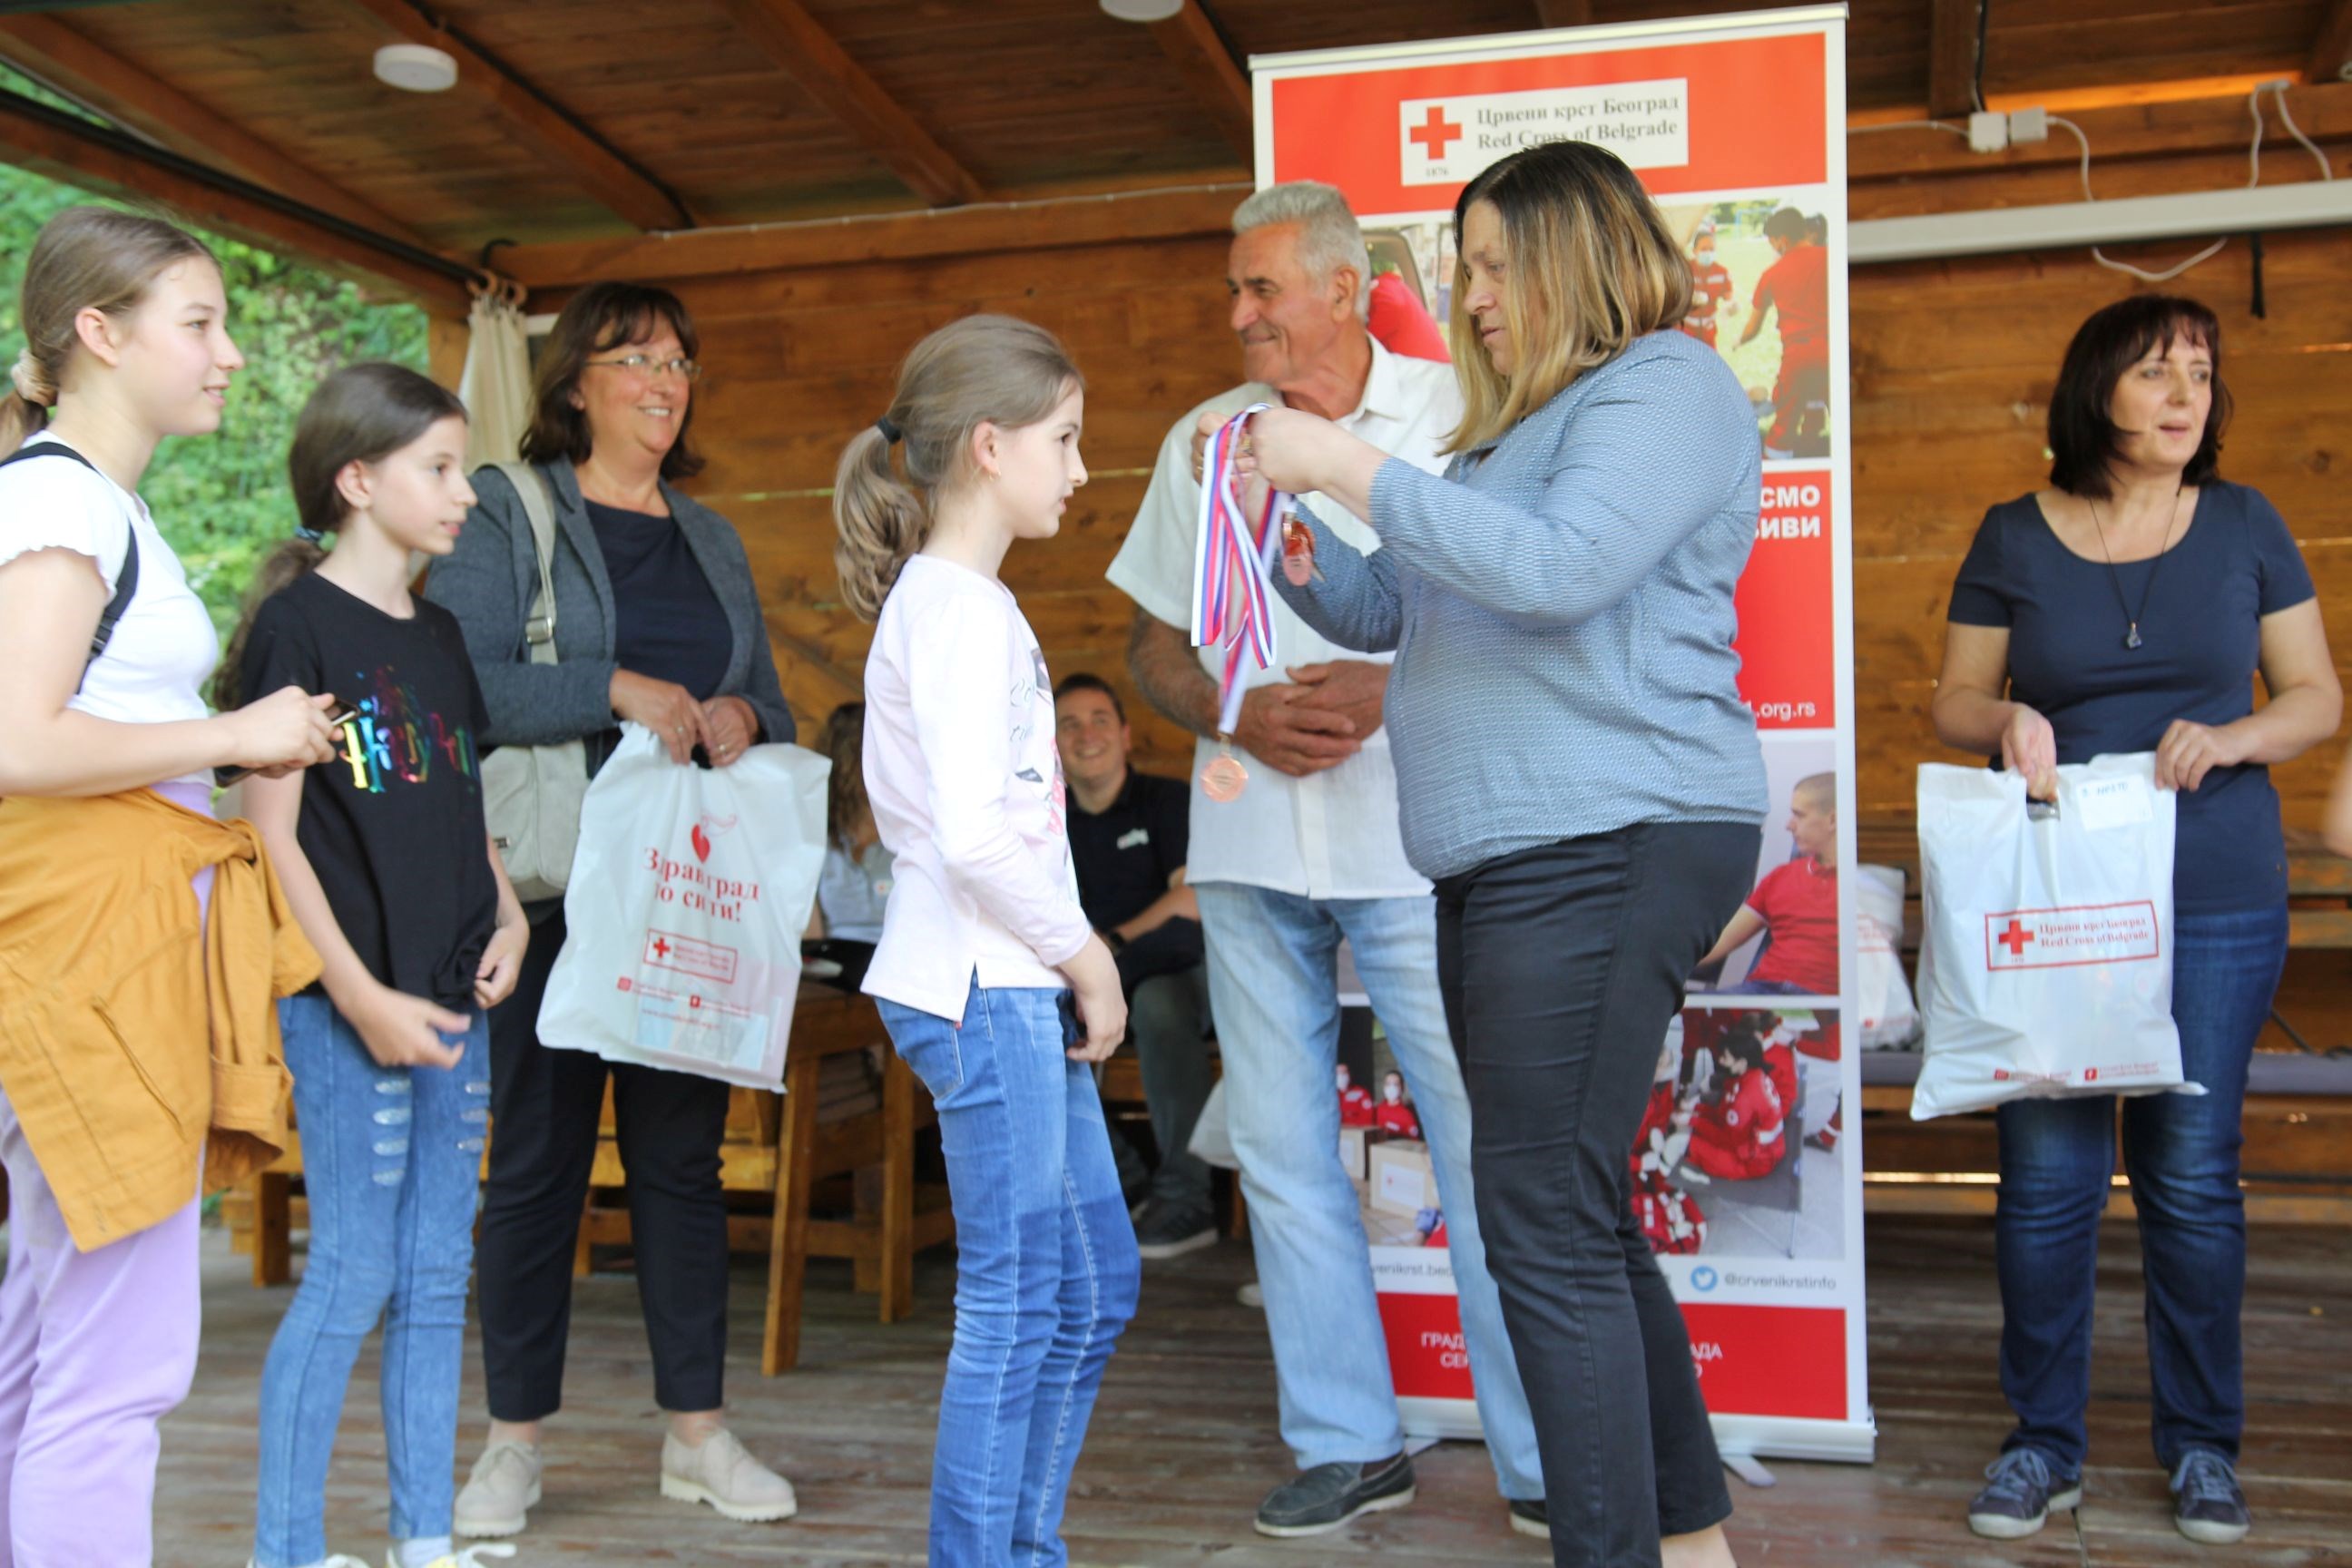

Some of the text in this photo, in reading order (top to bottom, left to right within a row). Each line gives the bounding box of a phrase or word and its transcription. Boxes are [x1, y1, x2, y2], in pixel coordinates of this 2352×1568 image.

[1476, 96, 1680, 126] Црвени крст Београд
[1477, 132, 1513, 149] Red
[1573, 124, 1592, 141] of
[1597, 119, 1678, 141] Belgrade
[1724, 1272, 1837, 1289] @crvenikrstinfo
